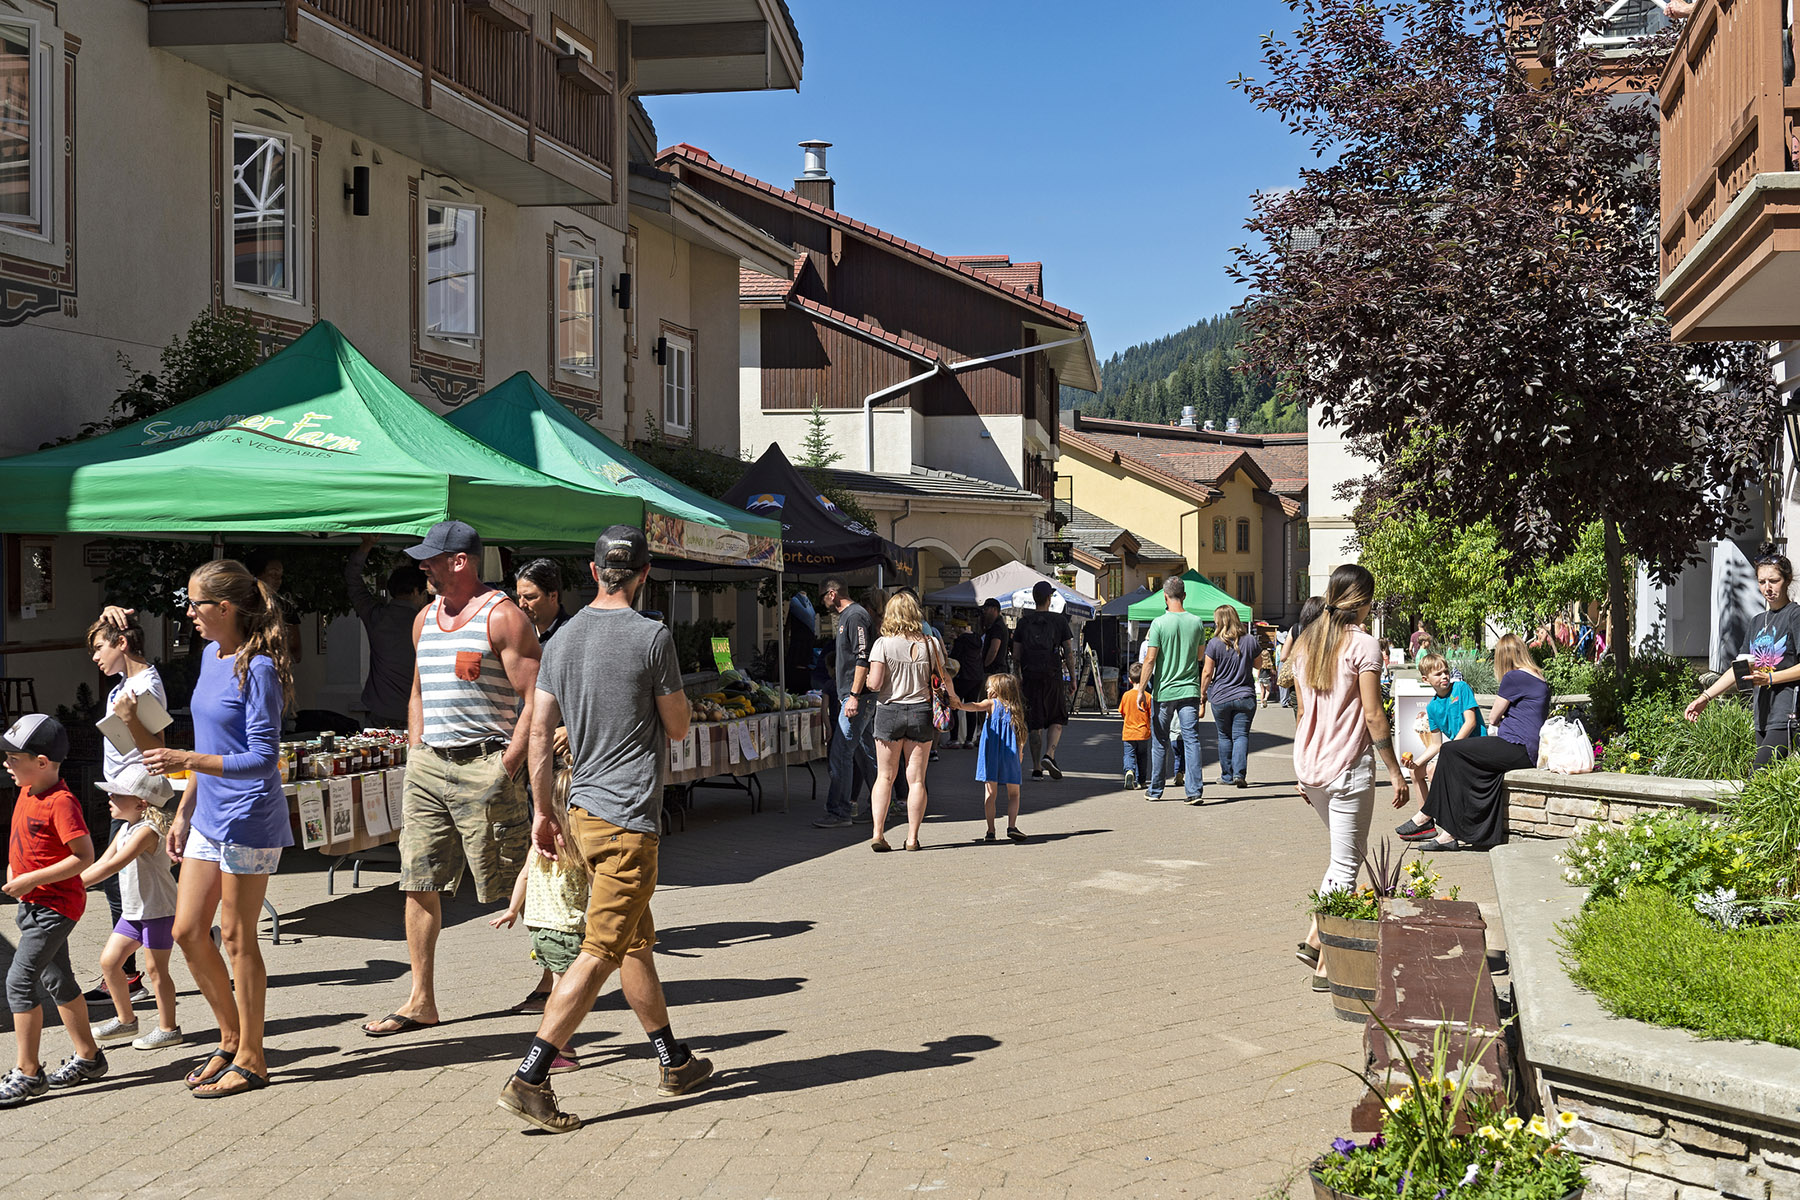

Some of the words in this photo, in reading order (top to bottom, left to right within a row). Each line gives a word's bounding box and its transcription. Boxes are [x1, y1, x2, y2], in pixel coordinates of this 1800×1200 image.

[141, 414, 285, 445] Summer
[284, 411, 361, 451] Farm
[248, 440, 334, 459] VEGETABLES
[783, 551, 835, 564] ort.com
[518, 1045, 542, 1073] GIRO
[654, 1037, 672, 1065] GIRO
